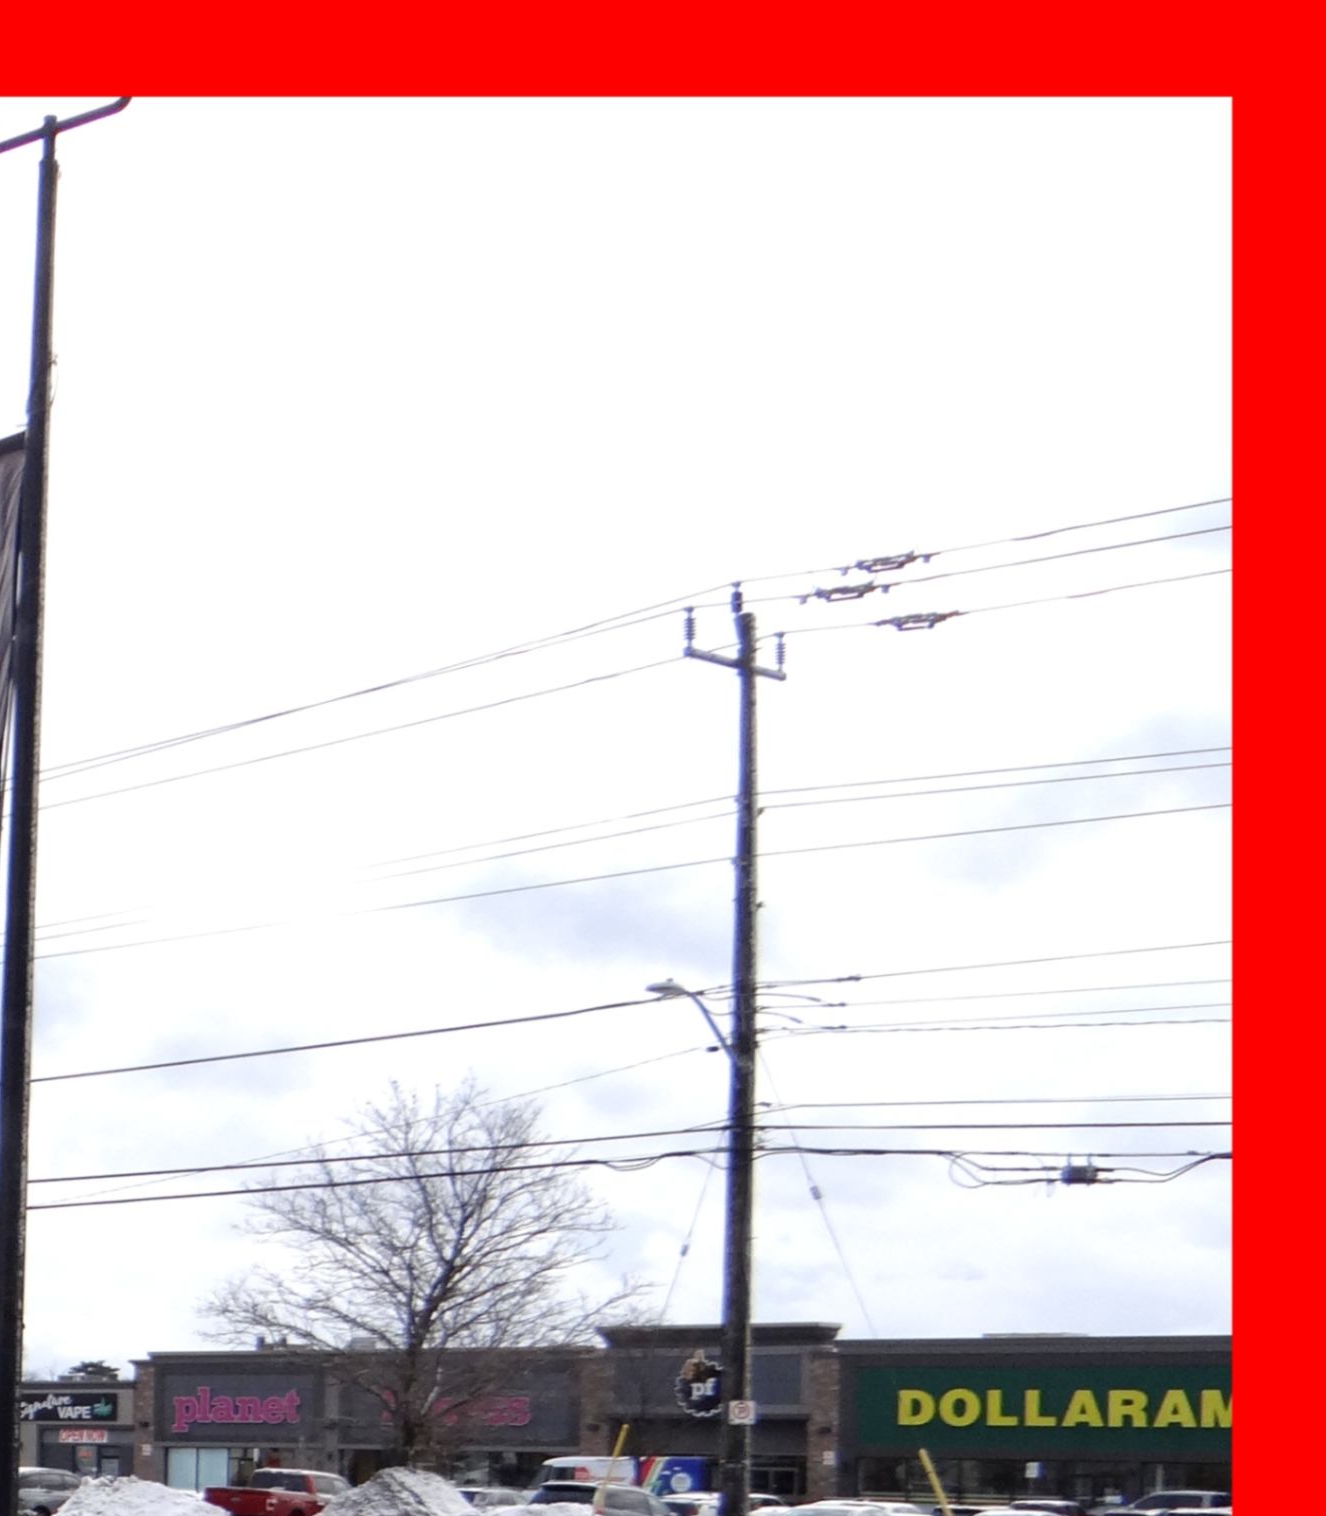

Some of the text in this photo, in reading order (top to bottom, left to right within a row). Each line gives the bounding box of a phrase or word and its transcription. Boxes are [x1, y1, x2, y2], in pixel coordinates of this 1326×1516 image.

[691, 1378, 716, 1399] pf
[57, 1406, 91, 1419] VAPE
[173, 1387, 300, 1432] planet
